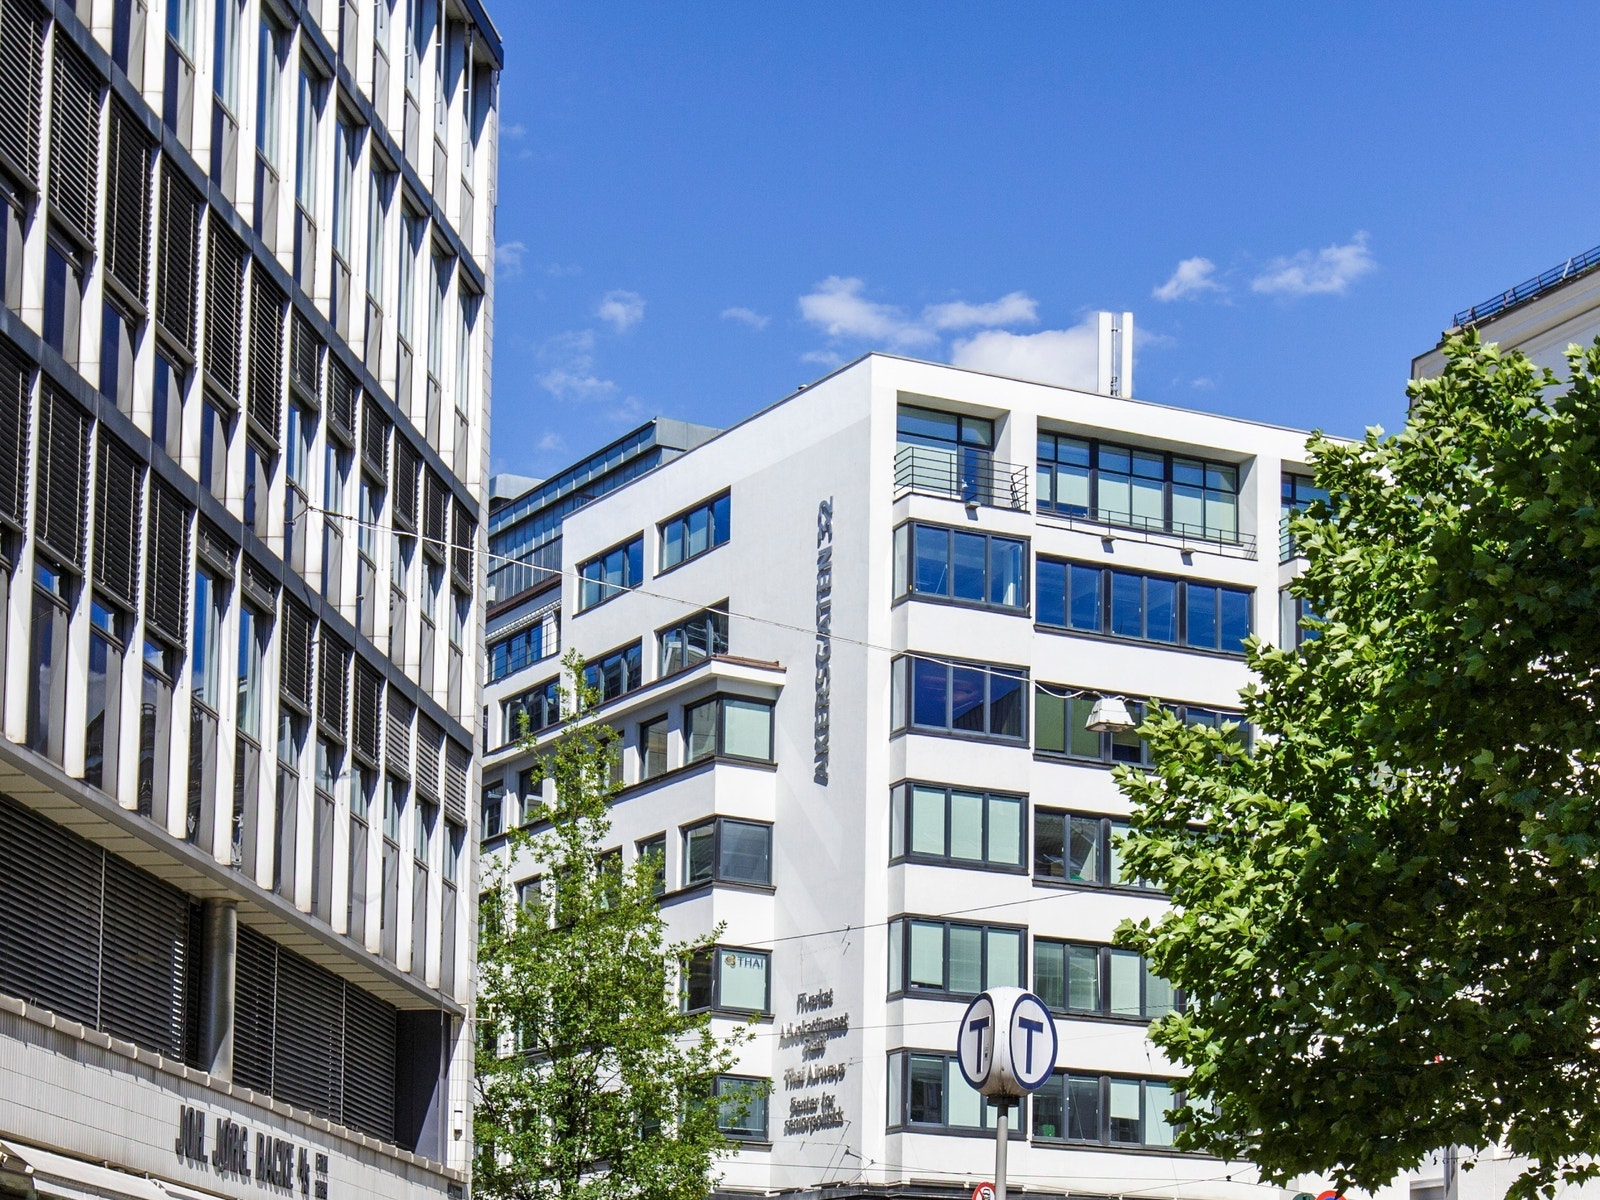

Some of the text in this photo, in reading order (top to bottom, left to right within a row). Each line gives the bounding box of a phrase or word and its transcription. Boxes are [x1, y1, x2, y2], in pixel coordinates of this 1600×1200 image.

[738, 957, 764, 970] THAI
[970, 1016, 989, 1074] T
[1018, 1016, 1043, 1074] T
[784, 1061, 846, 1087] Thai Airways
[790, 1091, 836, 1113] Senter for
[255, 1132, 294, 1189] BACKE
